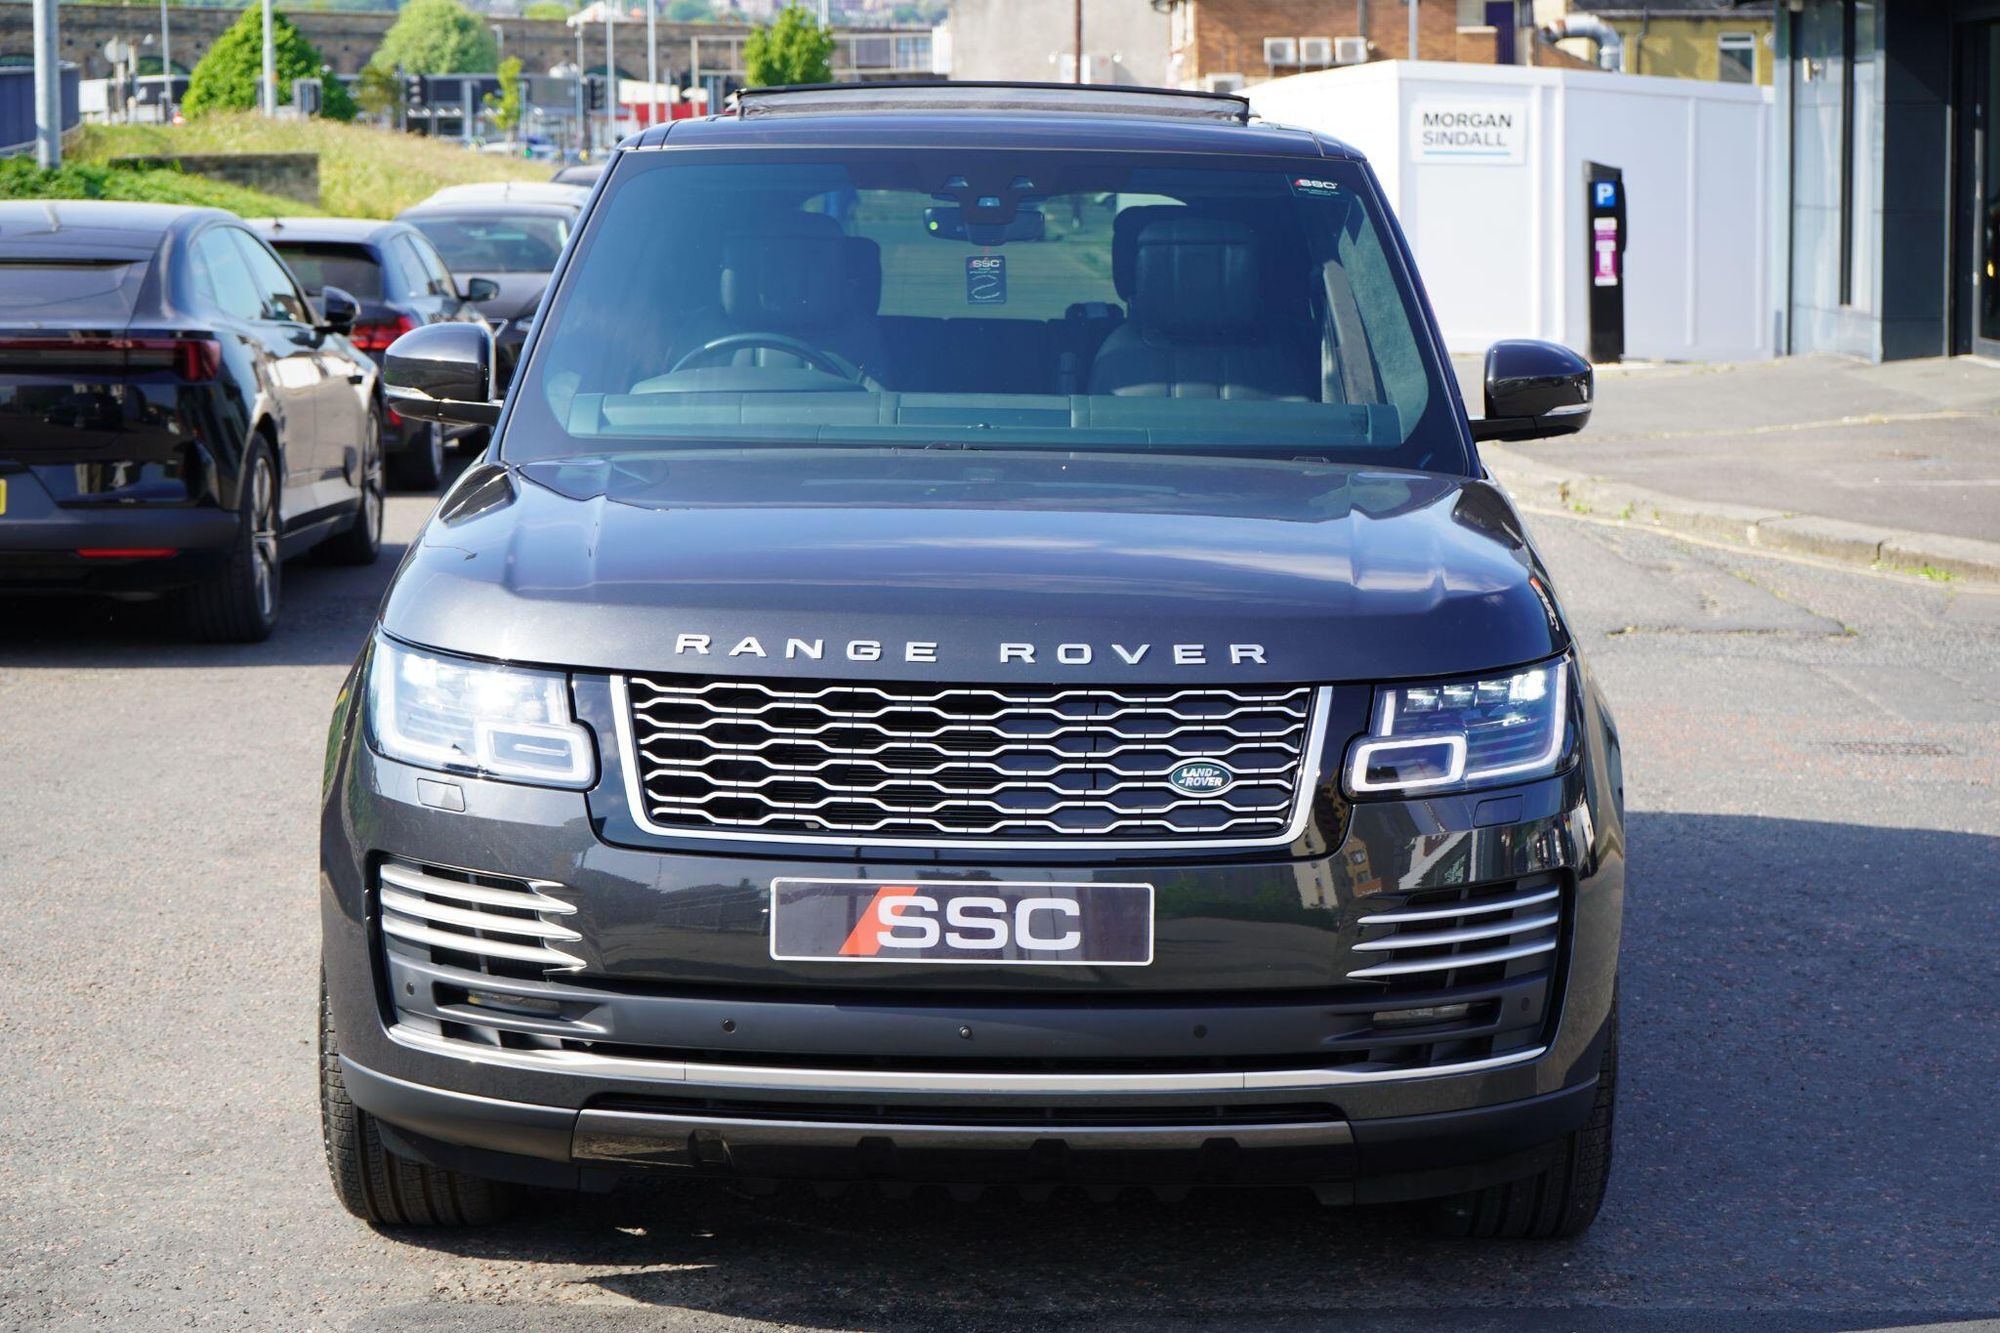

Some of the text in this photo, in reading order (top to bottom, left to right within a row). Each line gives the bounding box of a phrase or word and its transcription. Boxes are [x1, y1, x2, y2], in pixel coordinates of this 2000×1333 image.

[1423, 112, 1512, 128] MORGAN
[1422, 130, 1507, 147] SINDALL
[1597, 183, 1614, 205] P
[971, 259, 1000, 268] SSC
[675, 633, 1268, 664] RANGE ROVER
[876, 896, 1081, 950] SSC
